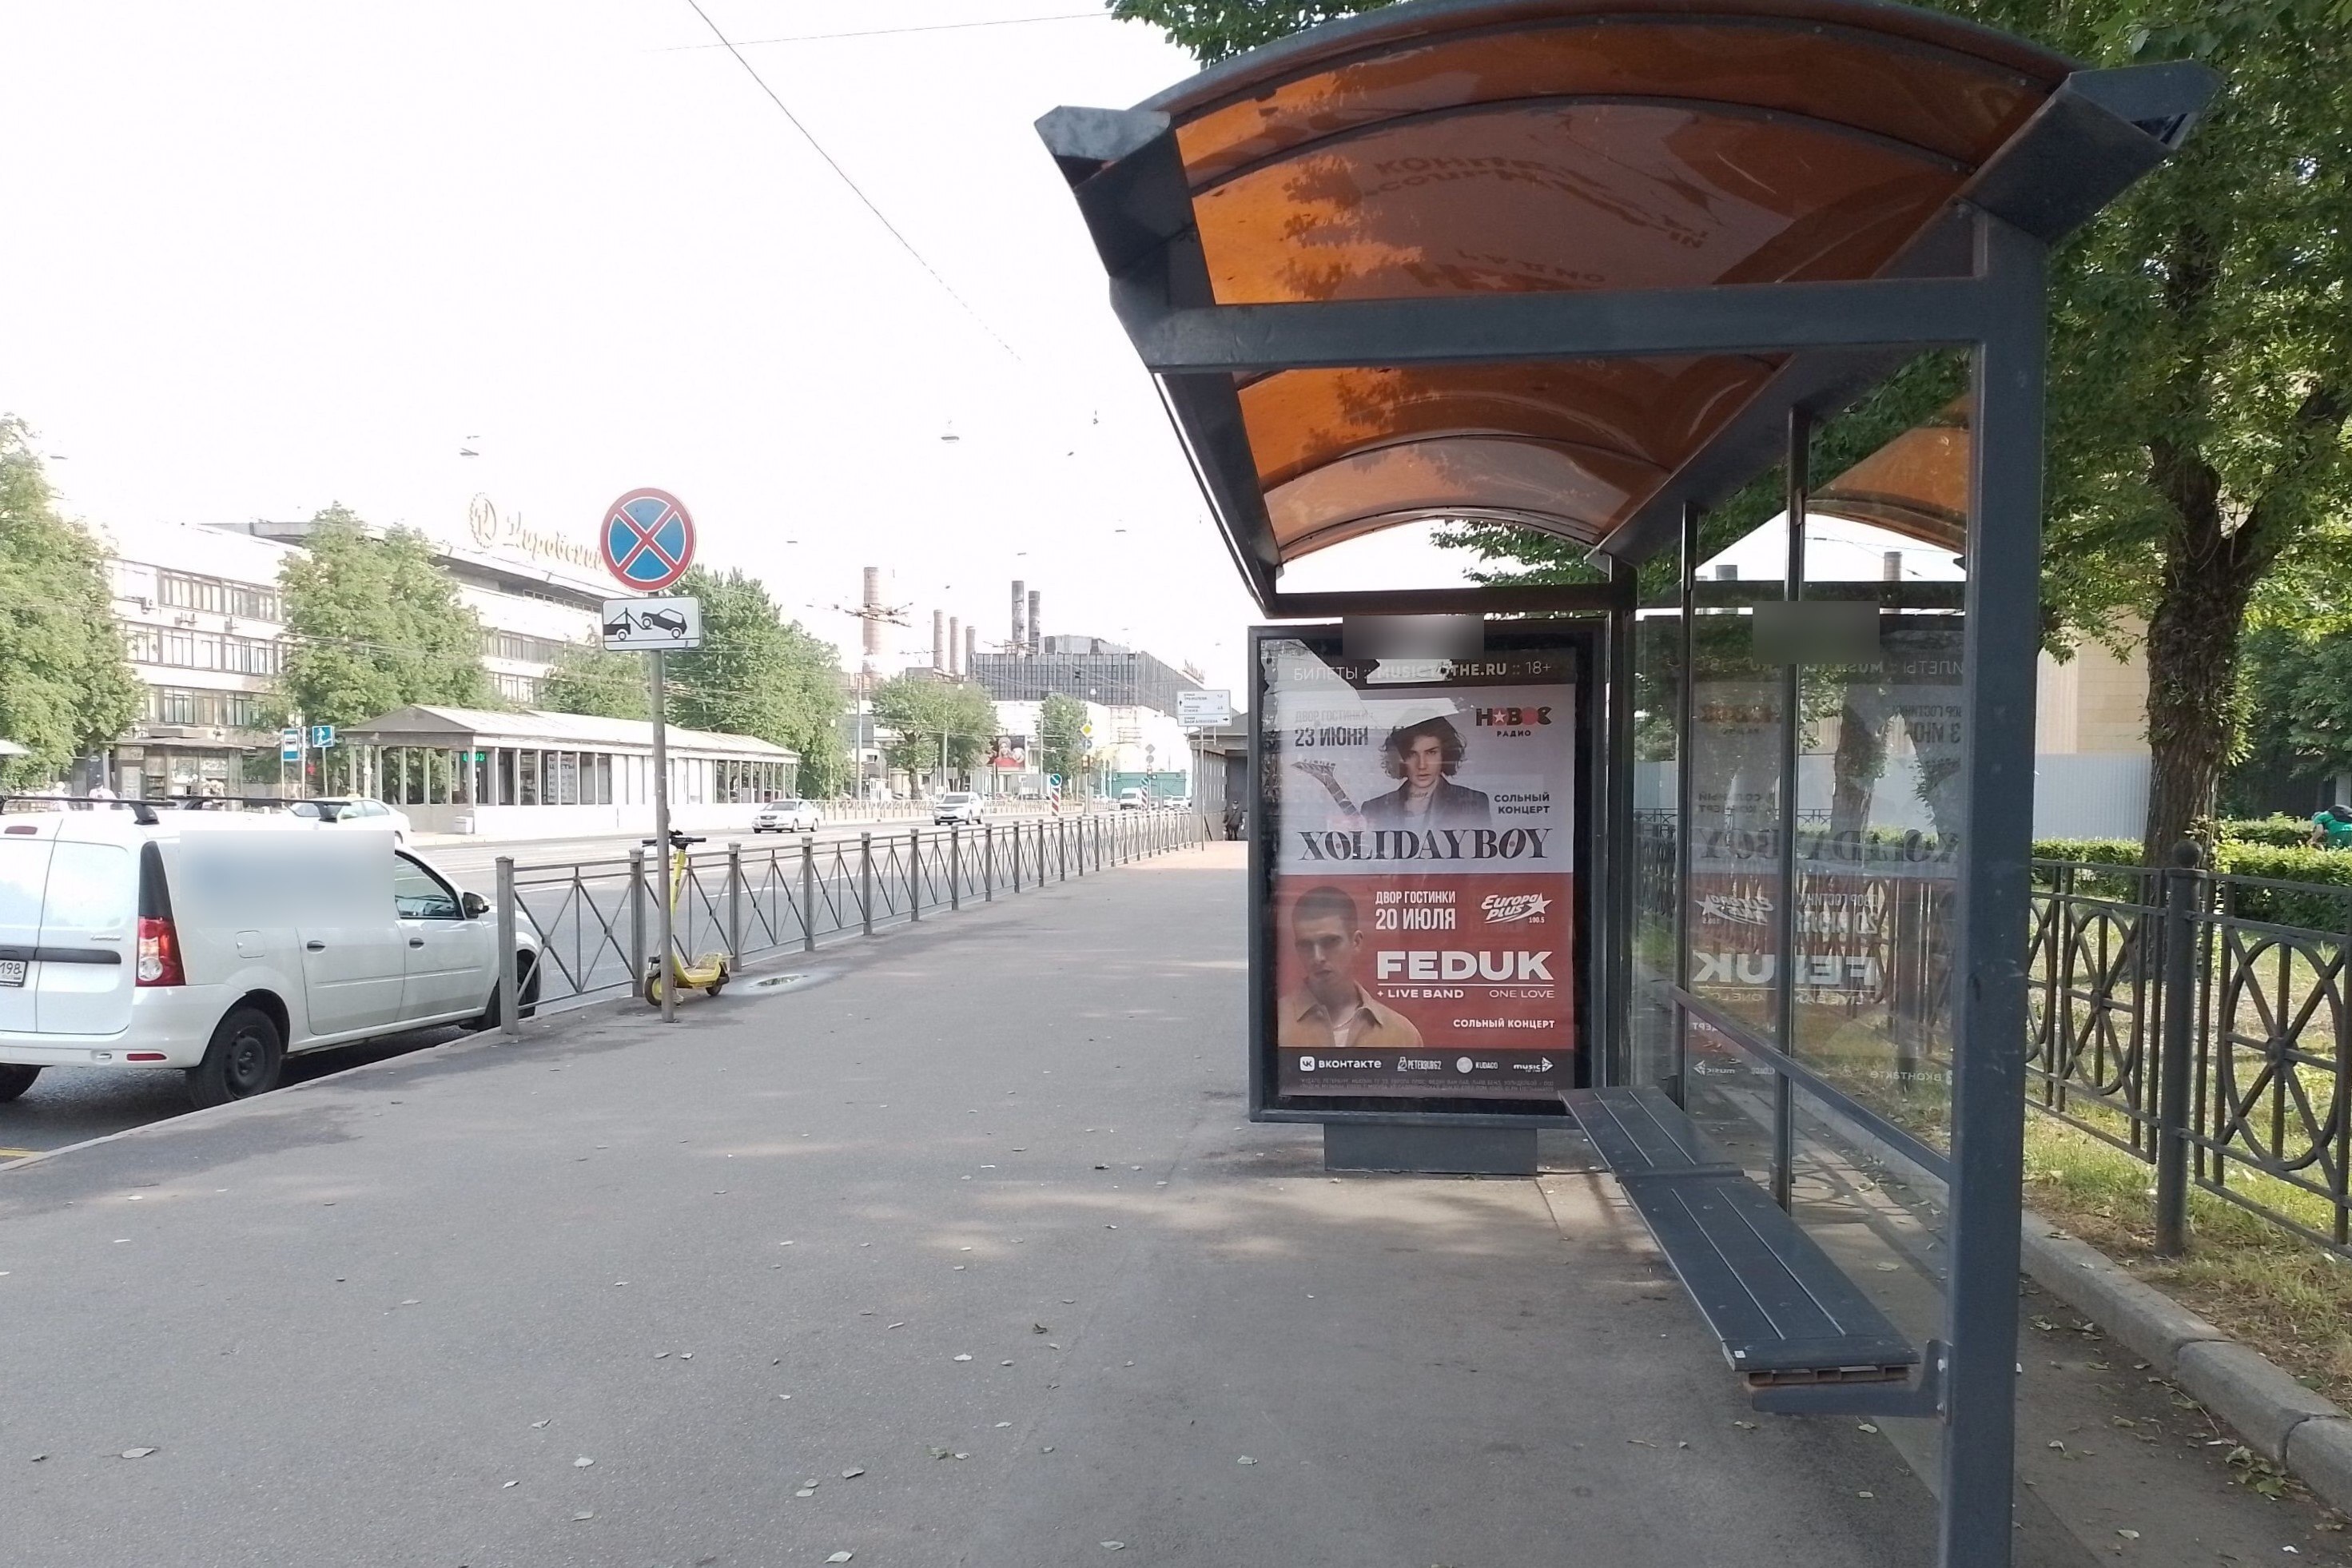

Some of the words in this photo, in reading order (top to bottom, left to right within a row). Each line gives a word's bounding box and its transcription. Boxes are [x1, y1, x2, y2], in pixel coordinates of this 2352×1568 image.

[1293, 667, 1359, 681] БИЛЕТЫ
[1526, 661, 1552, 675] 18+
[1295, 710, 1319, 723] ДВОР
[1295, 726, 1315, 747] 23
[1494, 792, 1550, 803] СОЛЬНЫЙ
[1498, 804, 1550, 815] КОНЦЕРТ
[1375, 891, 1403, 905] ДВОР
[1404, 890, 1456, 905] ГОСТИНКИ
[1375, 909, 1399, 930] 20
[1403, 908, 1456, 930] ИЮЛЯ
[0, 961, 22, 975] 198
[1376, 951, 1554, 981] FEDUK
[1387, 989, 1419, 999] LIVE
[1423, 989, 1465, 998] BAND
[1489, 989, 1517, 999] ONE
[1520, 989, 1555, 999] LOVE
[1453, 1017, 1506, 1029] СОЛЬНЫЙ
[1507, 1018, 1555, 1029] КОНЦЕРТ
